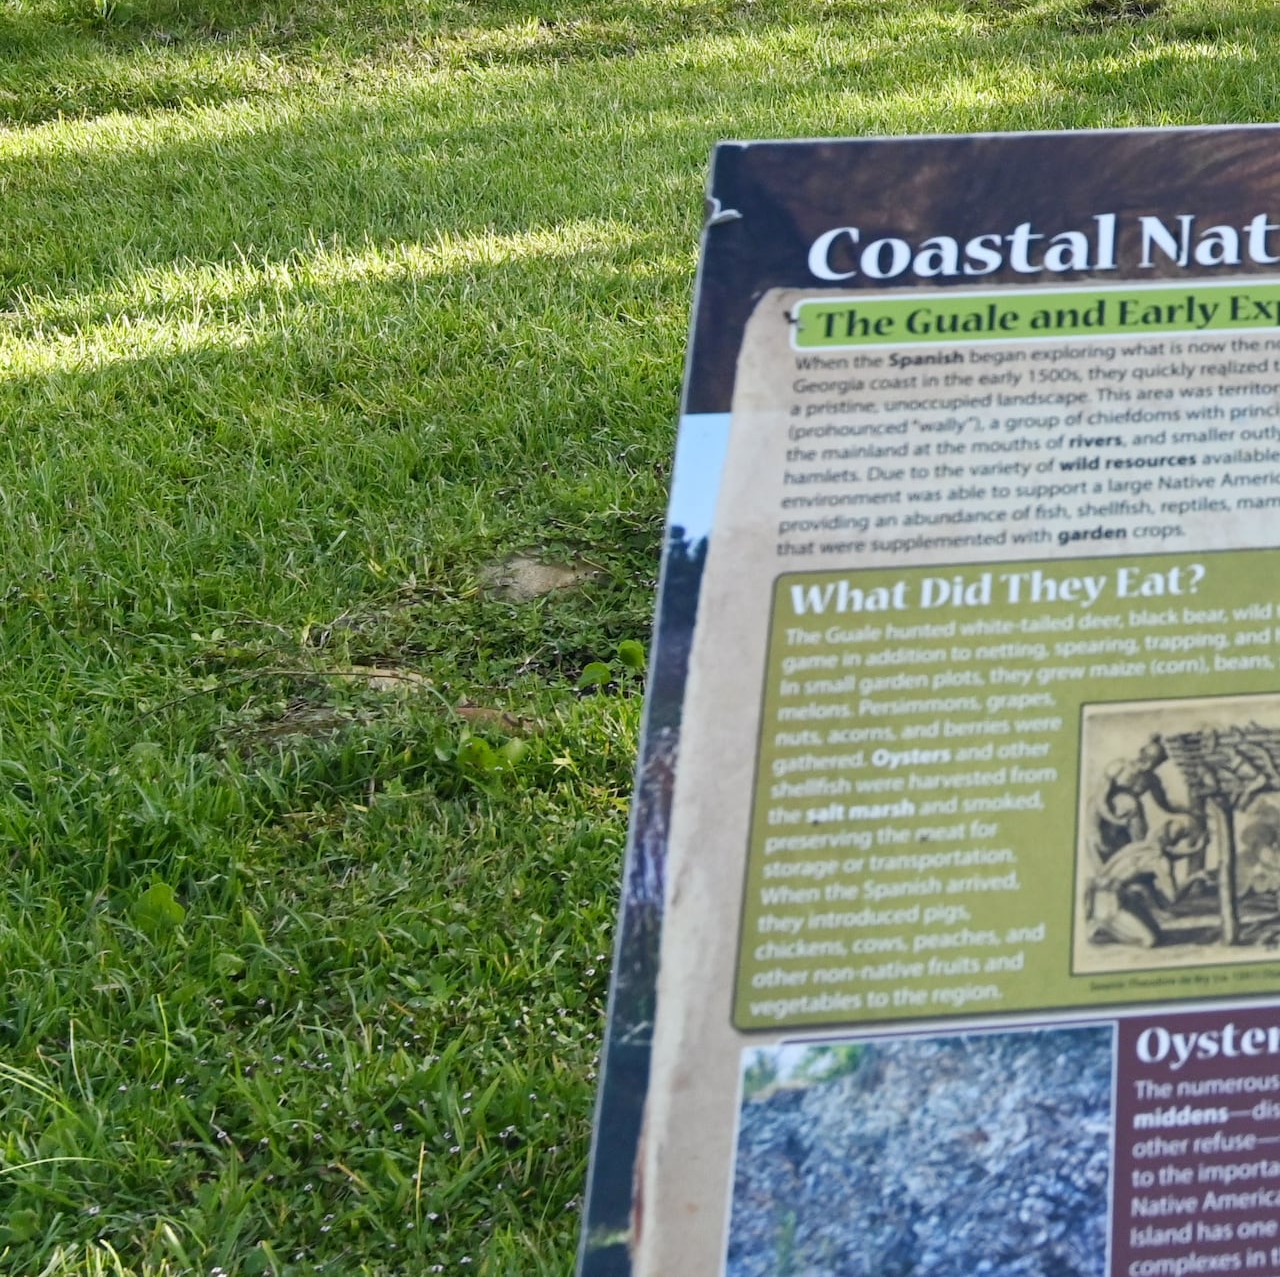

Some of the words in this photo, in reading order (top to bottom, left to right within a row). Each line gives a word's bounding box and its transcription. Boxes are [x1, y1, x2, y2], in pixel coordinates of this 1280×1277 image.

[807, 212, 1117, 282] Coastal
[816, 308, 894, 339] The
[904, 302, 1020, 336] Guale
[1028, 301, 1107, 329] and
[1117, 295, 1220, 331] Early
[795, 356, 849, 371] When
[853, 355, 883, 369] the
[888, 351, 965, 370] Spanish
[969, 351, 1027, 367] began
[1030, 347, 1116, 363] exploring
[1121, 343, 1164, 357] what
[1170, 344, 1183, 355] is
[1187, 342, 1226, 354] now
[1231, 339, 1260, 352] the
[792, 378, 865, 396] Georgia
[869, 376, 917, 391] coast
[922, 376, 939, 388] in
[944, 372, 973, 387] the
[978, 370, 1022, 387] early
[1029, 367, 1082, 383] 1500s,
[1088, 365, 1127, 383] they
[1132, 362, 1196, 381] quickly
[1200, 359, 1269, 376] realized
[789, 579, 911, 616] What
[920, 572, 994, 609] Did
[999, 568, 1108, 607] They
[1115, 563, 1207, 599] Eat?
[784, 627, 822, 645] The
[824, 625, 882, 643] Guale
[885, 620, 957, 639] hunted
[960, 614, 1074, 636] white-tailed
[1077, 613, 1124, 630] deer,
[1128, 608, 1178, 627] black
[1182, 607, 1229, 624] bear,
[1232, 602, 1273, 621] wild
[771, 751, 867, 777] gathered.
[871, 748, 951, 769] Oysters
[955, 743, 994, 761] and
[997, 741, 1051, 758] other
[1134, 1079, 1173, 1100] The
[1177, 1074, 1280, 1096] numerous
